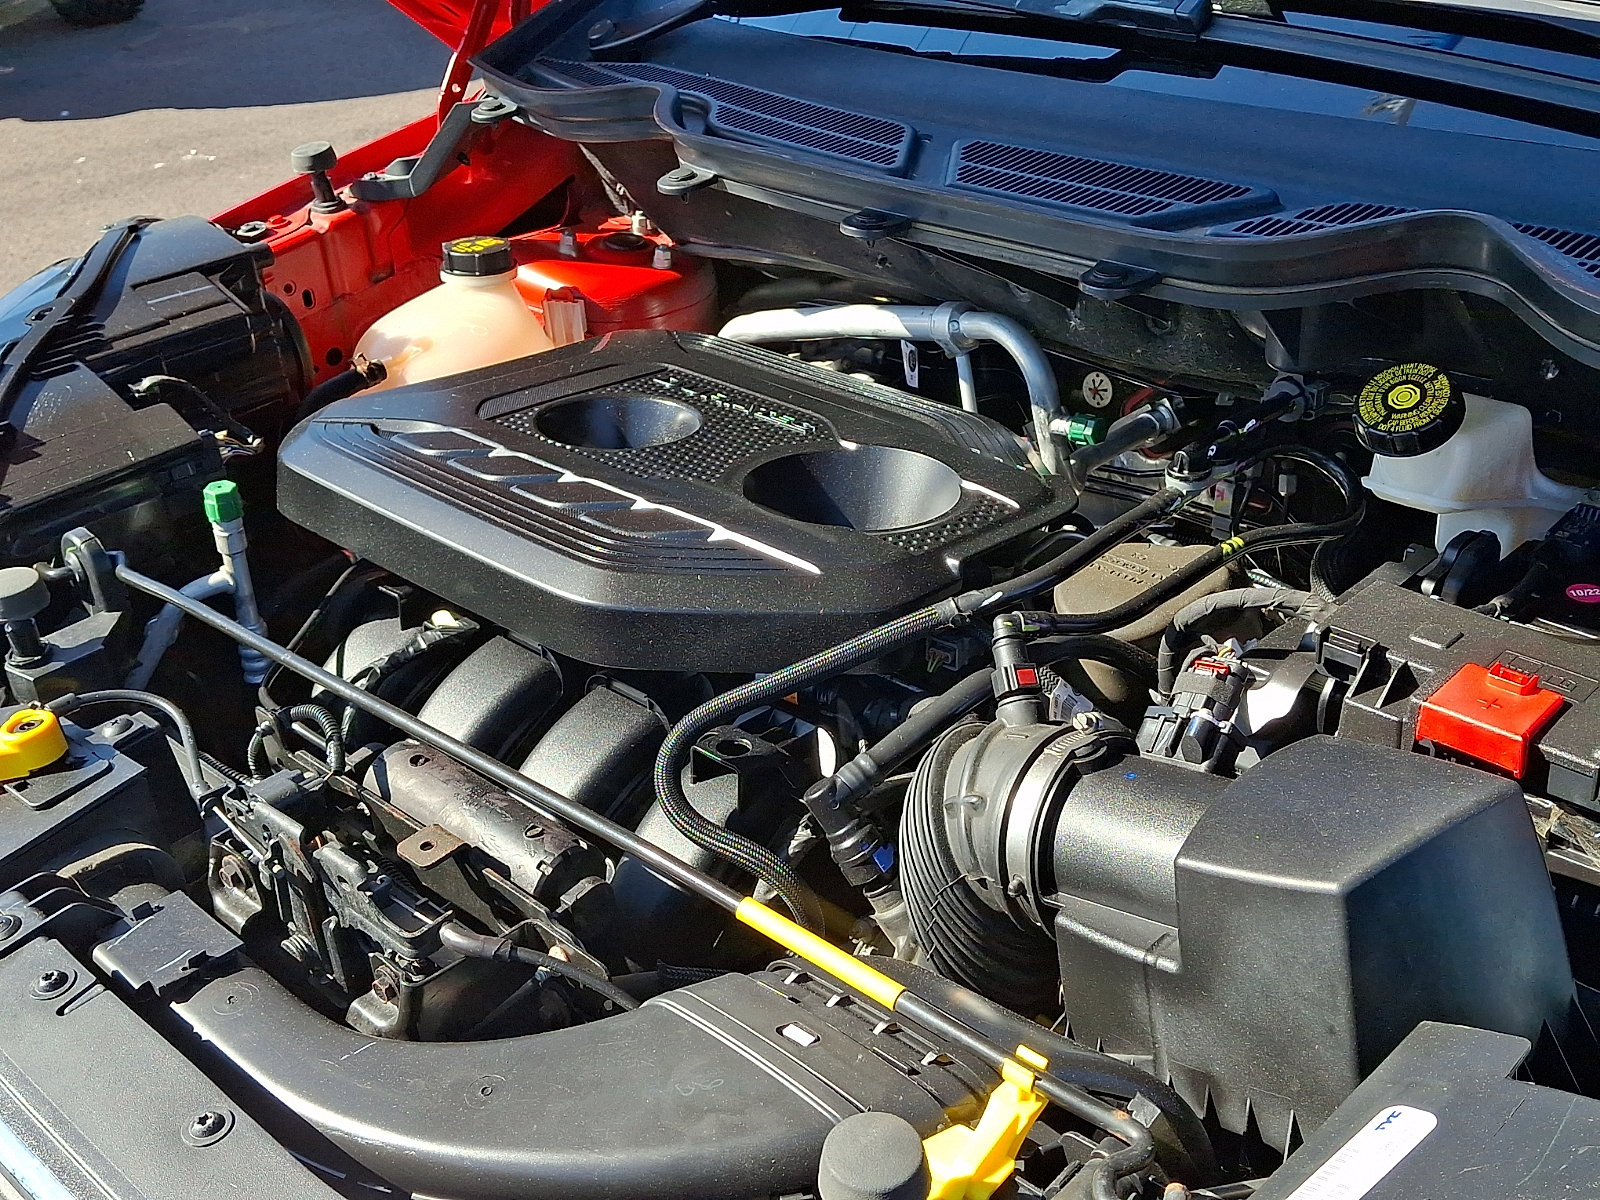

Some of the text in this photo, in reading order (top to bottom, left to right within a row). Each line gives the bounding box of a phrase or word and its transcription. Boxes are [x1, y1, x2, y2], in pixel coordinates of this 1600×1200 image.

[1378, 423, 1391, 431] DOT
[1396, 424, 1412, 432] FLUID
[1413, 417, 1430, 428] FROM
[1400, 416, 1421, 426] BEFORE
[1569, 588, 1600, 596] 10/22
